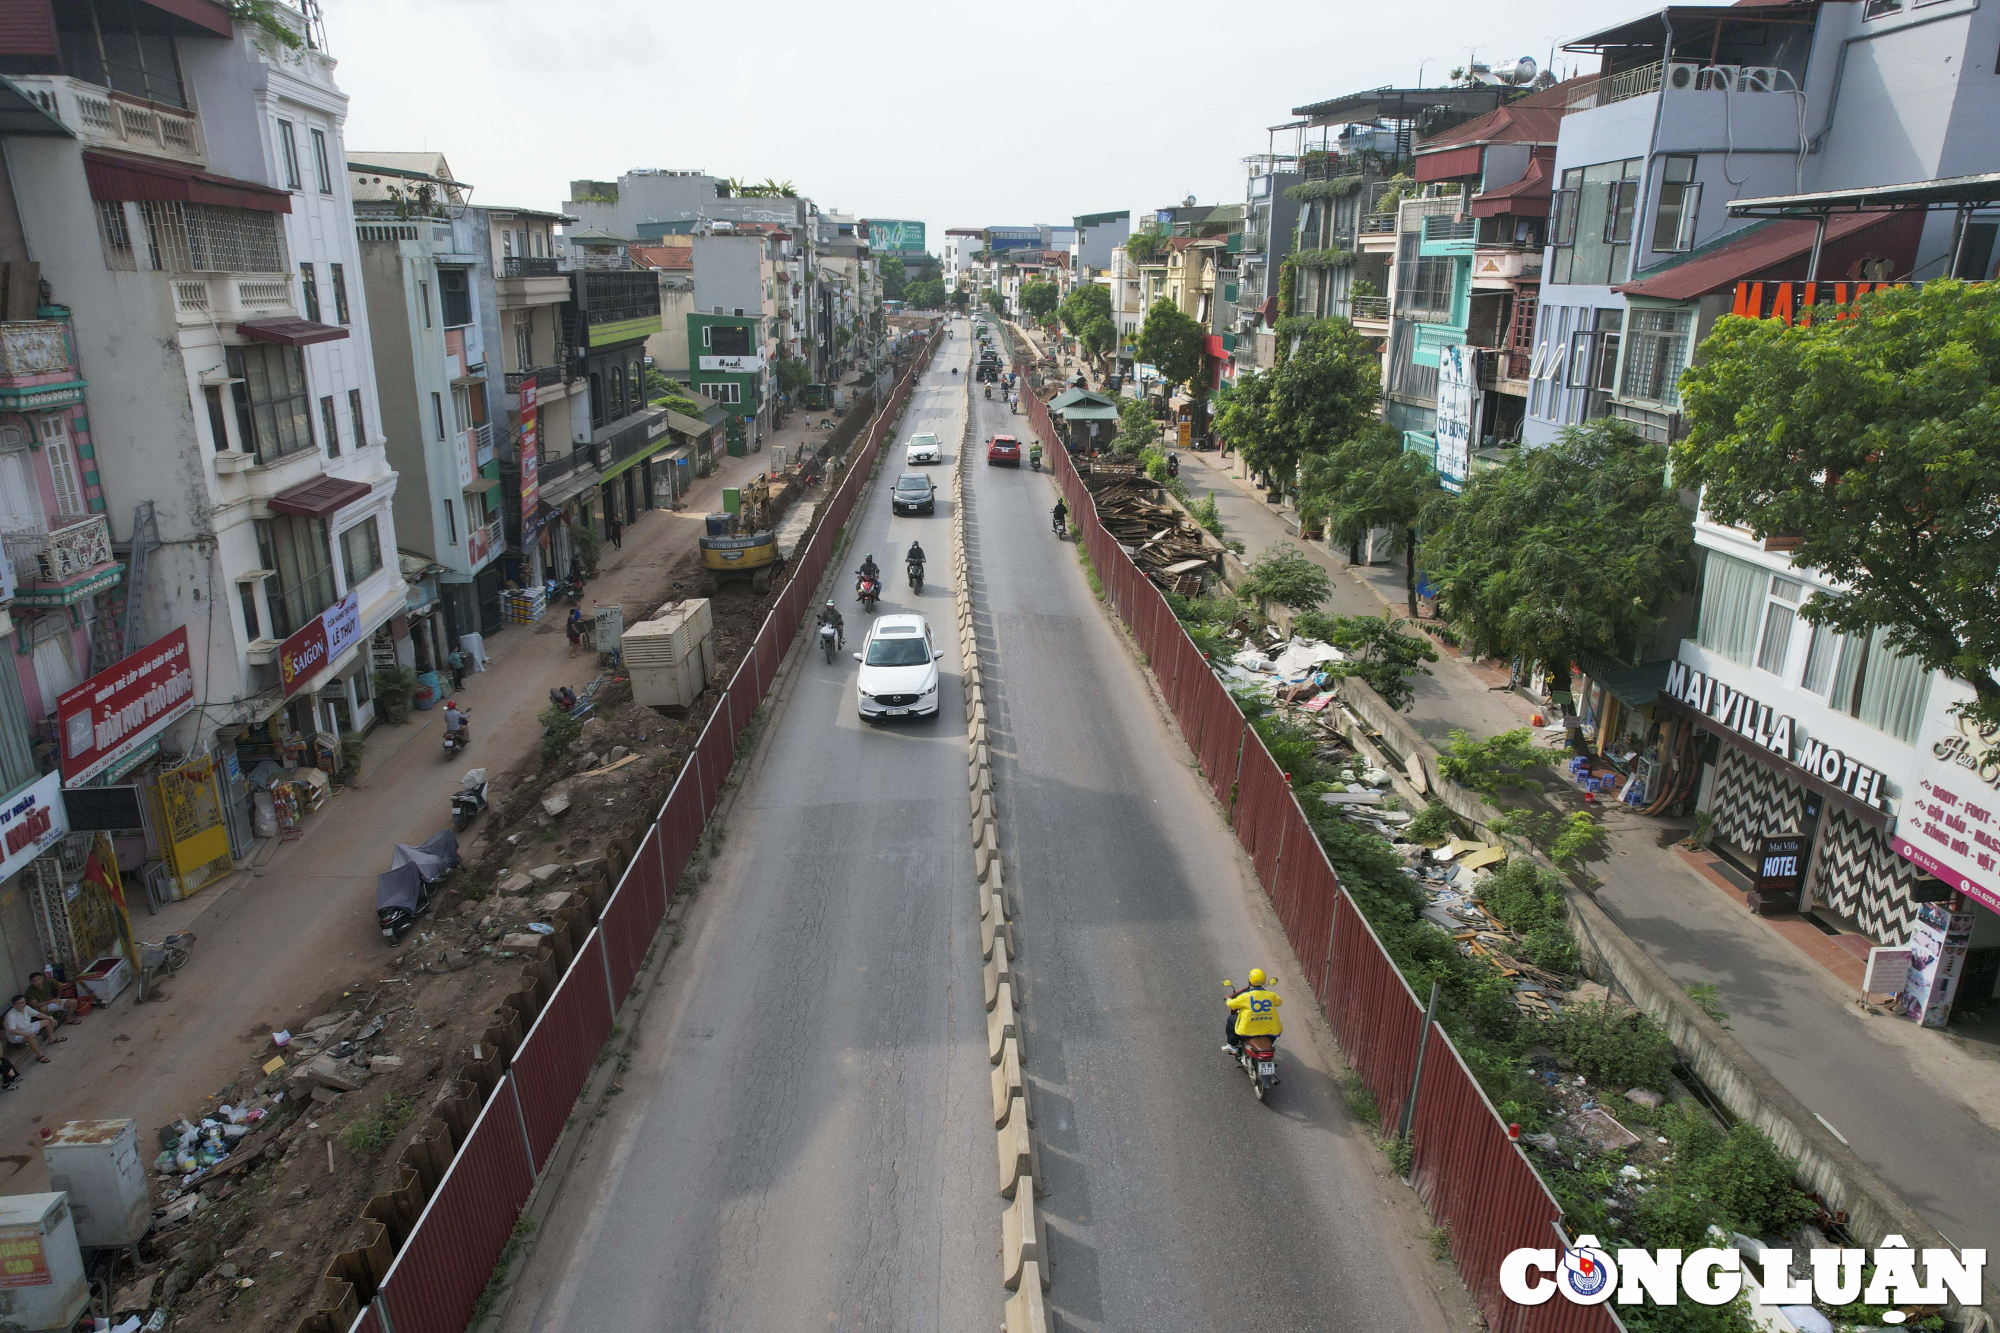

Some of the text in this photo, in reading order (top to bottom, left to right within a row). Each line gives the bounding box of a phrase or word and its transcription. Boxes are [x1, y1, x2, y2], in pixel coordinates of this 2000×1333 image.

[332, 628, 340, 646] LÊ
[293, 639, 324, 676] SAIGON
[95, 684, 115, 704] NHÓM
[115, 674, 126, 692] TRẺ
[126, 670, 138, 686] LỚP
[152, 654, 164, 670] GIÁO
[175, 642, 185, 656] LẬP
[95, 704, 123, 751] MẦM
[120, 697, 146, 734] NON
[144, 682, 167, 719] TÁO
[164, 663, 192, 705] HỒNG
[1665, 659, 1887, 810] MAI VILLA MOTEL
[12, 794, 36, 817] NHÂN
[1927, 804, 1944, 822] GỘI
[1932, 785, 1958, 807] BODY
[1964, 802, 1991, 824] FOOT
[5, 805, 51, 855] MẶT
[1769, 841, 1798, 851] Mai Villa
[1923, 822, 1950, 847] XÔNG
[1977, 851, 1997, 872] VẬT
[1762, 856, 1797, 877] HOTEL
[1250, 996, 1272, 1013] be
[5, 1259, 34, 1274] CÁO
